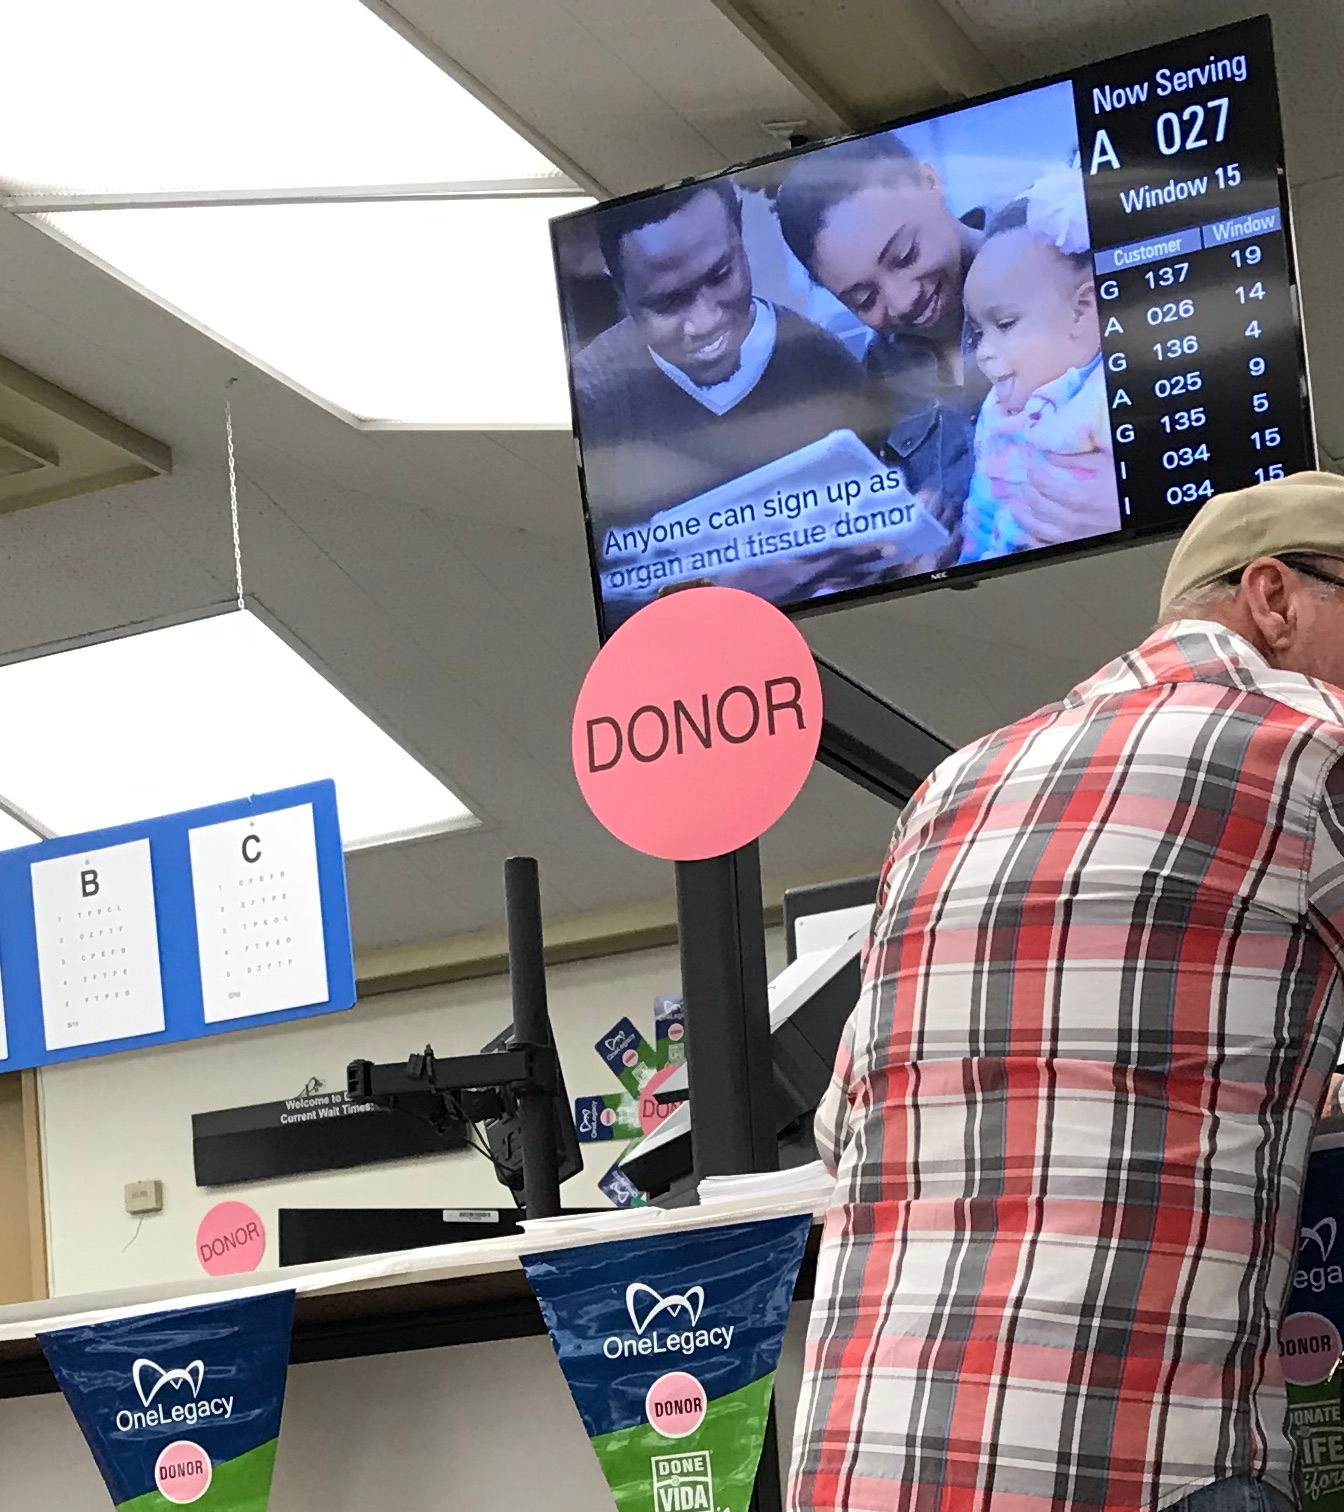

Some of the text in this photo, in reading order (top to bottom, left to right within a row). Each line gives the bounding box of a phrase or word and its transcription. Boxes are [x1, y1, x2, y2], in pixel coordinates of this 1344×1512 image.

[1092, 55, 1247, 114] Now Serving
[1090, 97, 1229, 176] A 027
[1120, 163, 1241, 214] Window 15
[1114, 214, 1275, 266] Customer Window
[1100, 246, 1262, 299] G 137 19
[1104, 282, 1266, 337] A 026 14
[1108, 320, 1262, 372] G 136 4
[1112, 357, 1265, 409] A 025 9
[1116, 393, 1269, 443] G 135 5
[1163, 444, 1211, 469] 034
[1251, 427, 1281, 450] 15
[605, 469, 900, 556] Anyone can sign up as
[1166, 479, 1215, 506] 034
[609, 503, 916, 589] organ and tissue donor
[586, 676, 807, 773] DONOR
[242, 834, 262, 863] C
[80, 869, 100, 897] B
[280, 1108, 317, 1124] Current
[318, 1105, 340, 1119] Wait
[286, 1096, 330, 1111] Welcome
[332, 1094, 342, 1104] to
[200, 1222, 260, 1263] DONOR
[604, 1326, 735, 1359] OneLegacy
[116, 1396, 234, 1432] OneLegacy
[654, 1397, 702, 1418] DONOR
[1290, 1405, 1341, 1425] ONATE
[159, 1459, 204, 1481] DONOR
[658, 1455, 705, 1476] DONE
[659, 1484, 709, 1512] VIDA
